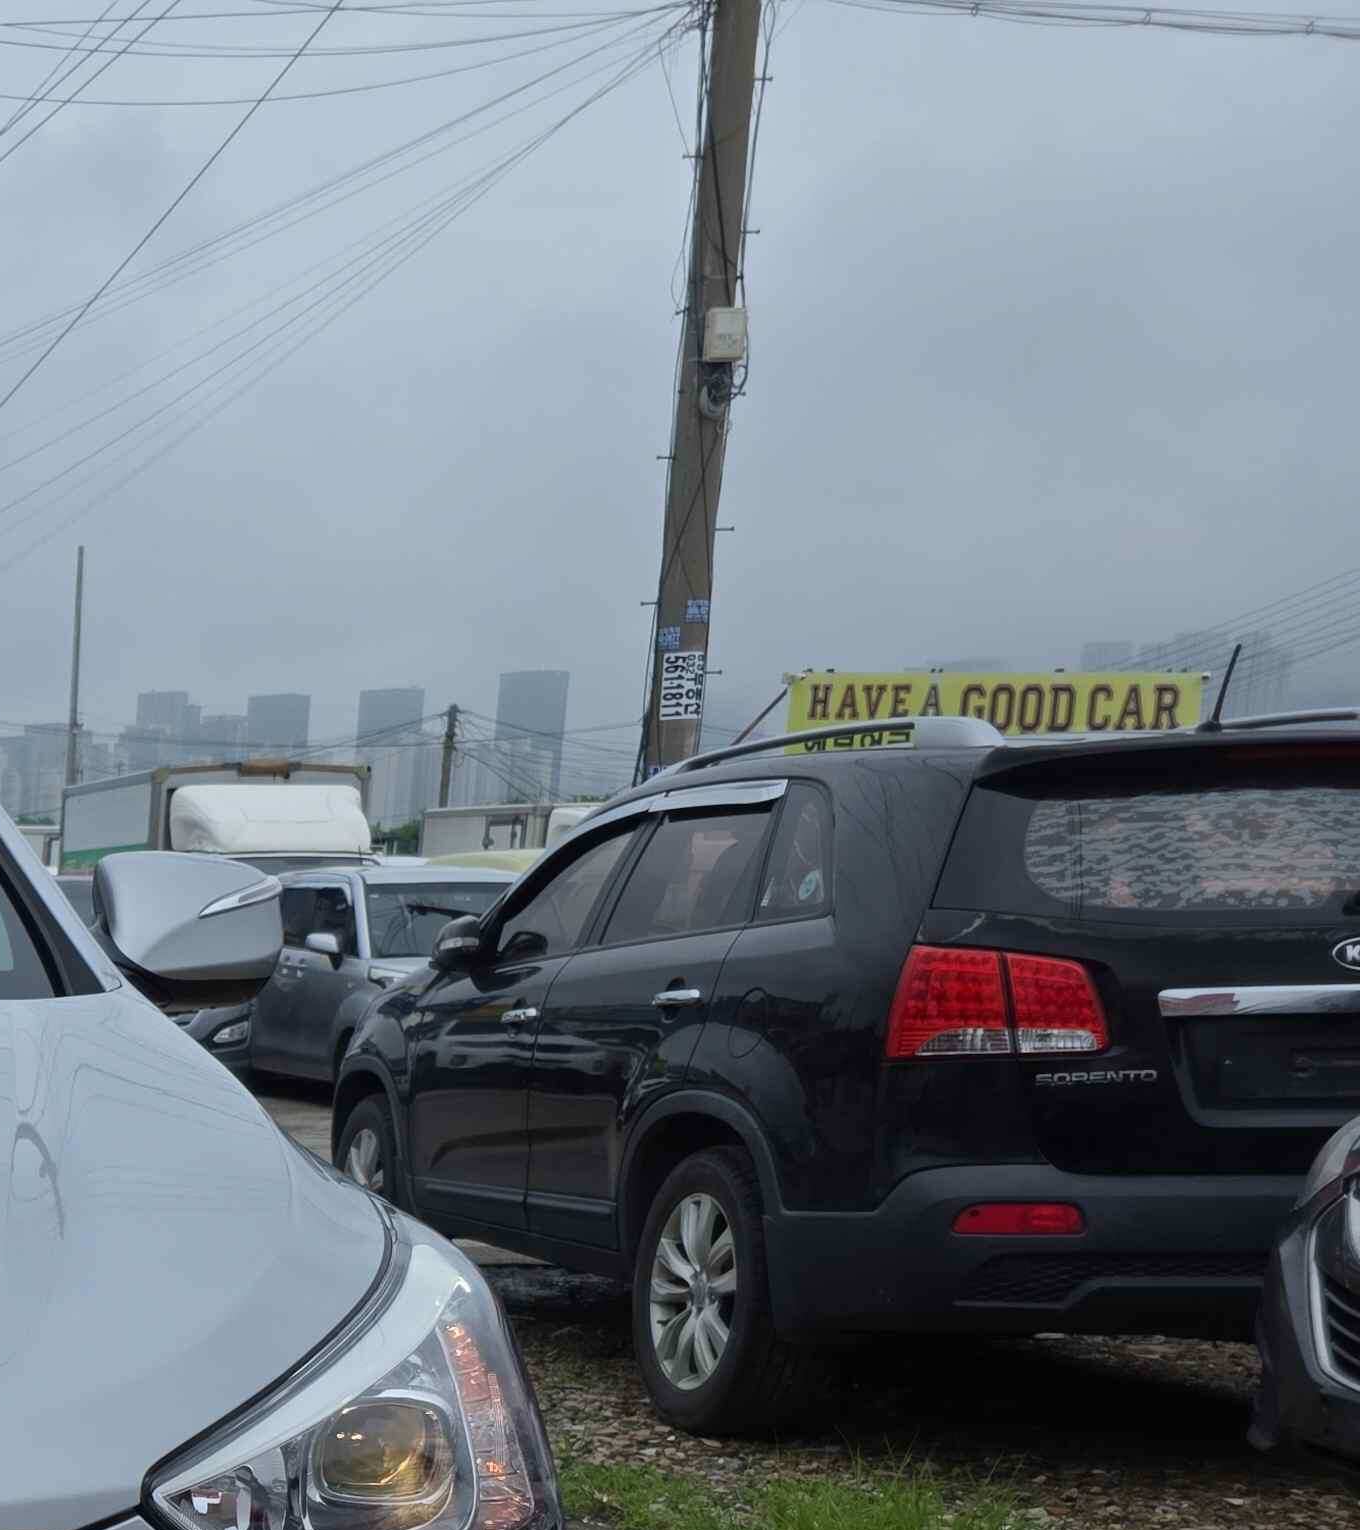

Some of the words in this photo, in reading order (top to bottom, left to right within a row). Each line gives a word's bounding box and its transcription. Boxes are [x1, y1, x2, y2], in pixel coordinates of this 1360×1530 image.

[807, 684, 912, 720] HAVE
[919, 683, 943, 716] A
[960, 684, 1078, 735] GOOD
[1086, 683, 1182, 731] CAR
[1035, 1069, 1157, 1086] SORENTO
